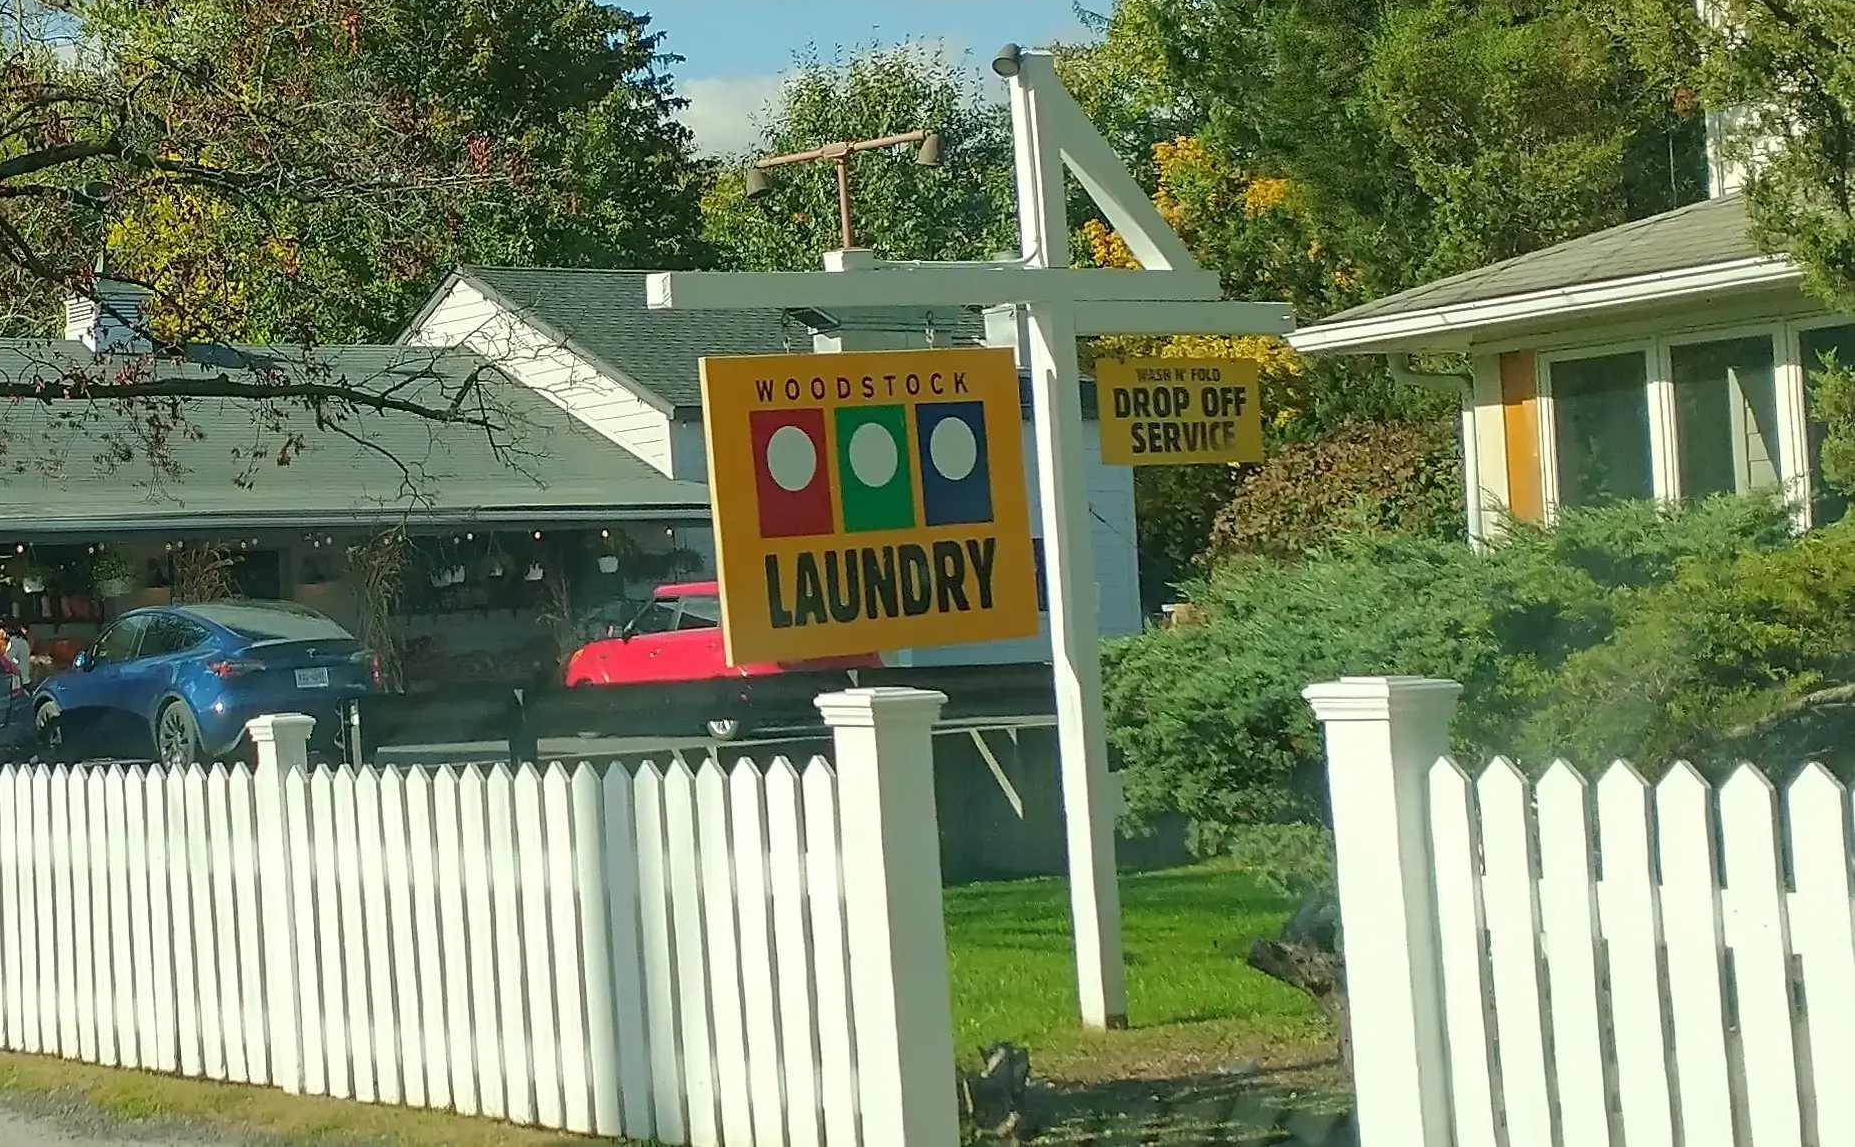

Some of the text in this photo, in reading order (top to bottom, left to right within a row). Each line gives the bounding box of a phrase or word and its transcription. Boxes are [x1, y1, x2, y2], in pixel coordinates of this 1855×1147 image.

[755, 372, 969, 402] WOODSTOCK
[1190, 367, 1221, 382] FOLD
[1113, 387, 1247, 419] DROP OFF
[1131, 421, 1236, 454] SERVICE
[765, 537, 995, 628] LAUNDRY
